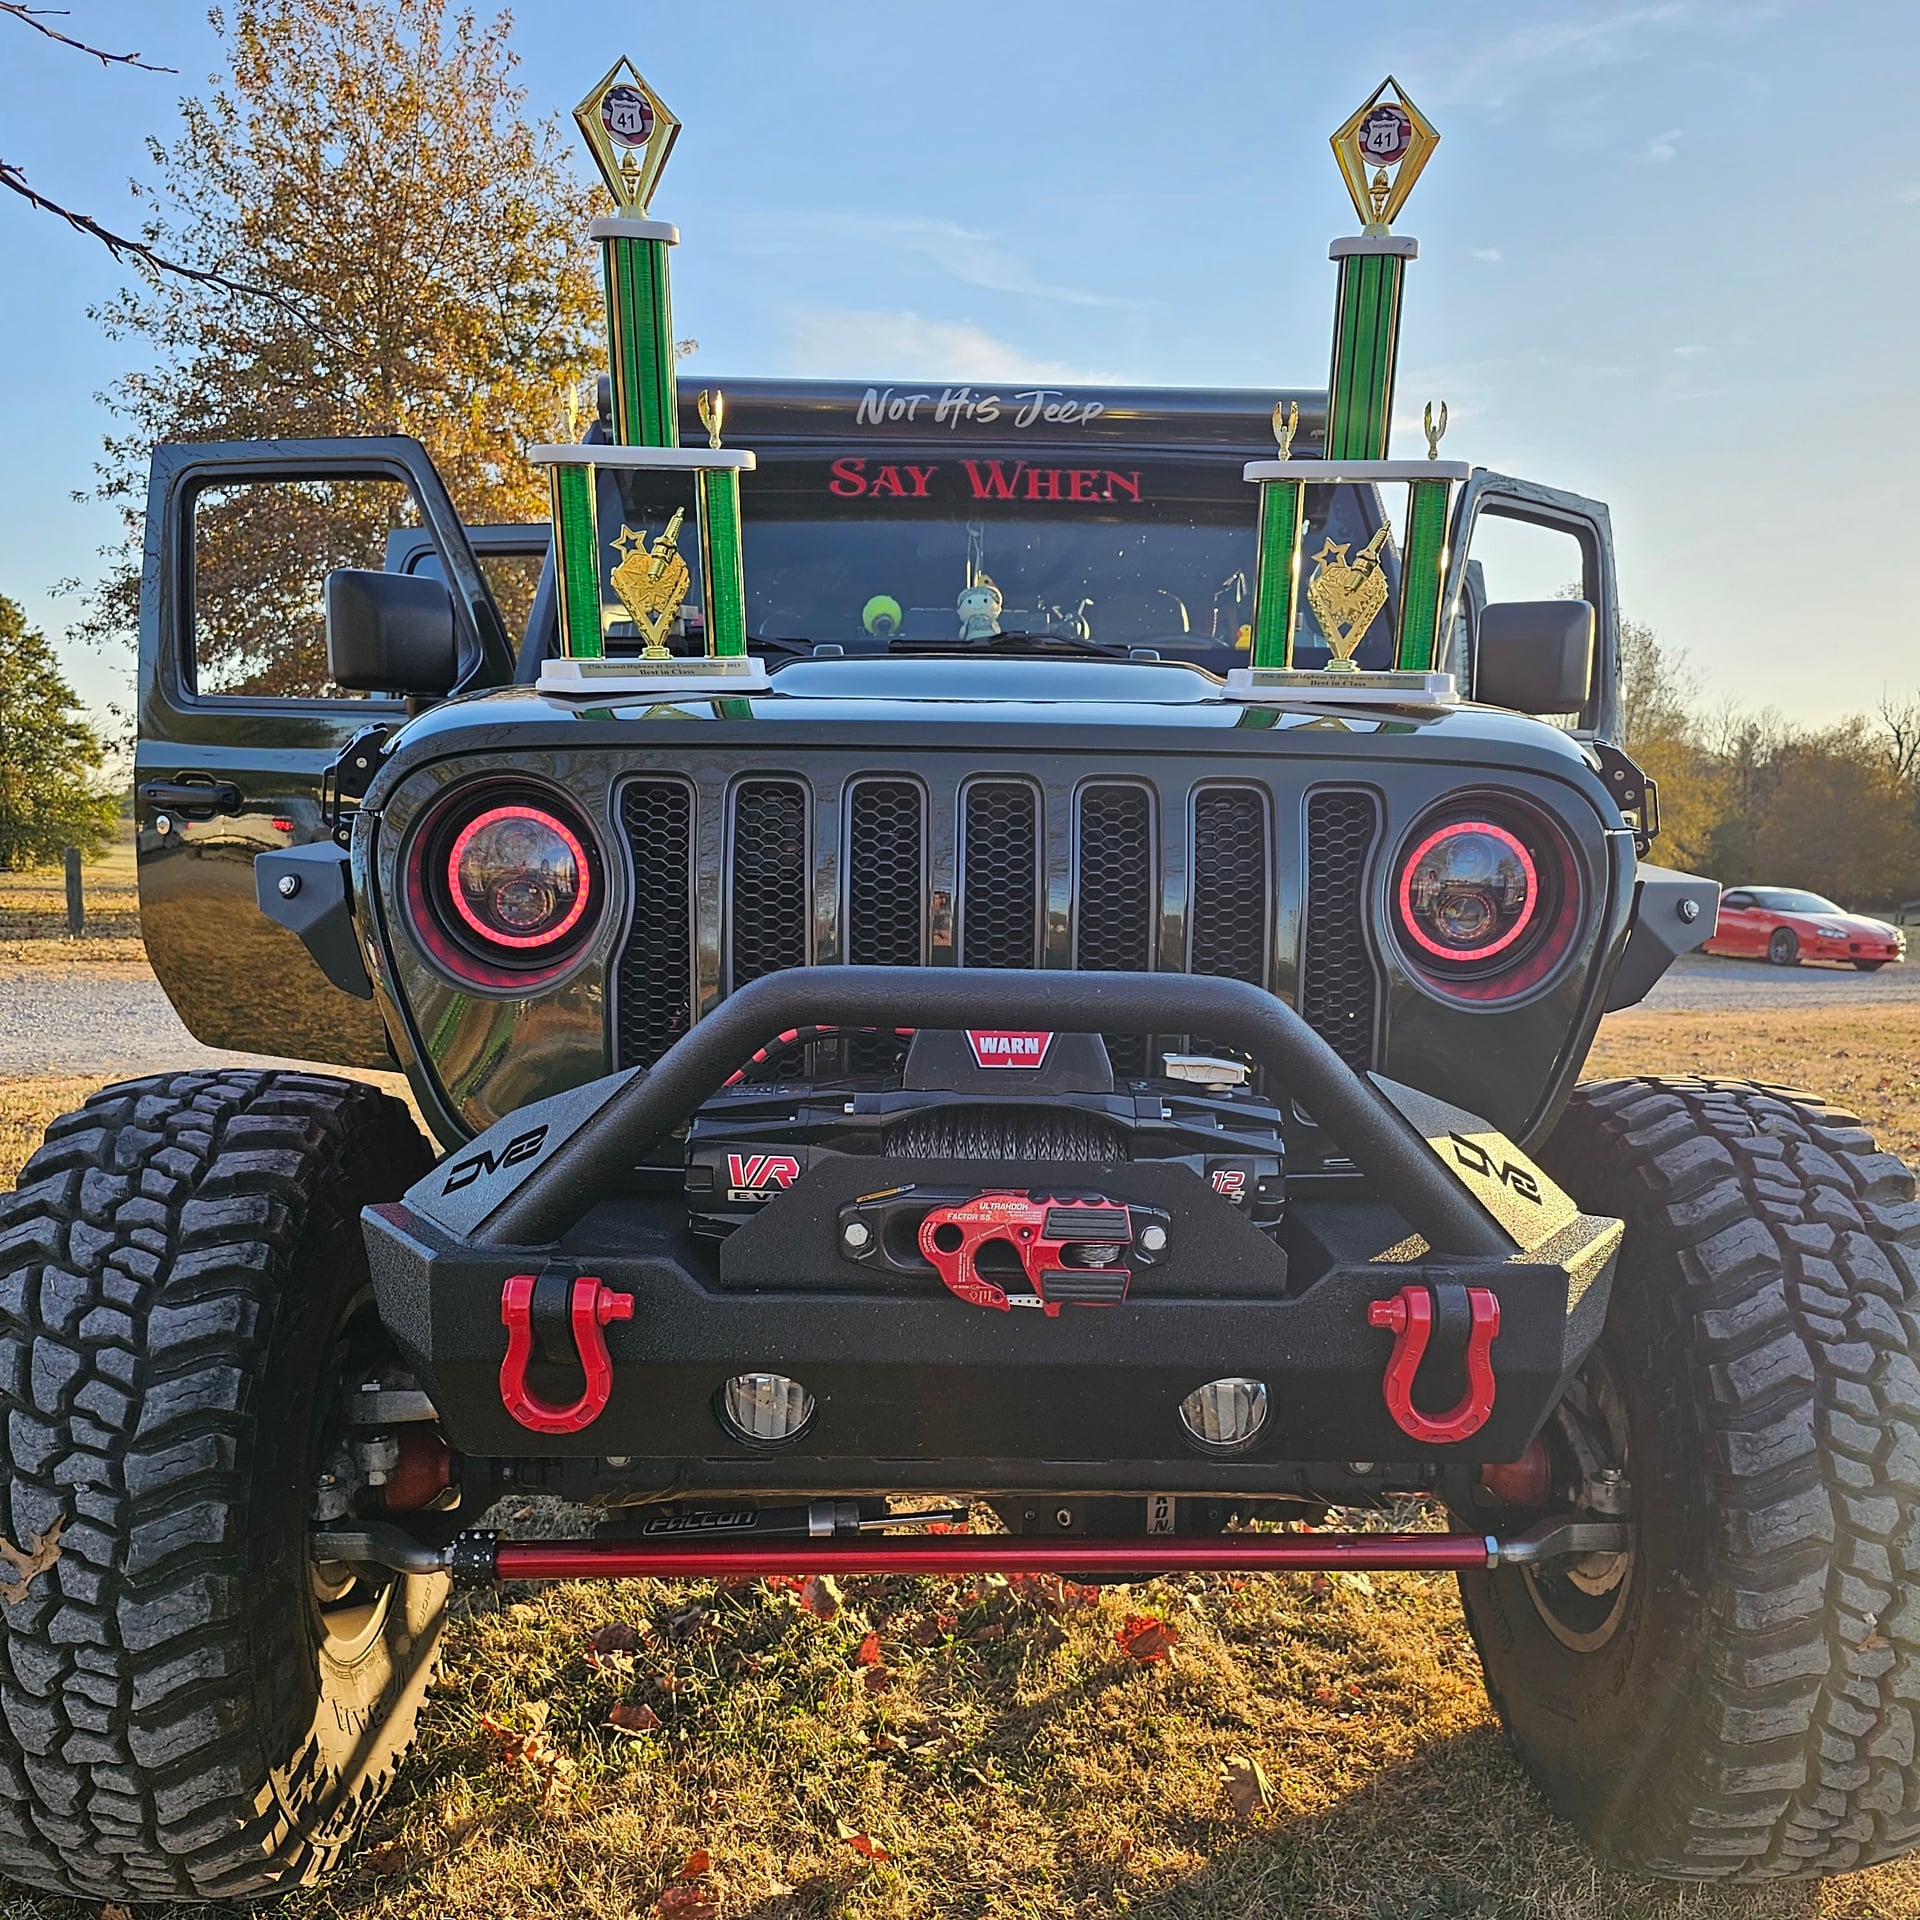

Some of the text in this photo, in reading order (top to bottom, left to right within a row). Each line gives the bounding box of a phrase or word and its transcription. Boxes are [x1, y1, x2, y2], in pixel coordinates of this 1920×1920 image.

[617, 112, 635, 129] 41
[1373, 132, 1391, 148] 41
[979, 1037, 1039, 1054] WARN
[728, 1154, 800, 1189] VR
[980, 1202, 1029, 1211] ULTRAHOOK
[980, 1213, 992, 1221] 55
[650, 1512, 753, 1531] FALCON
